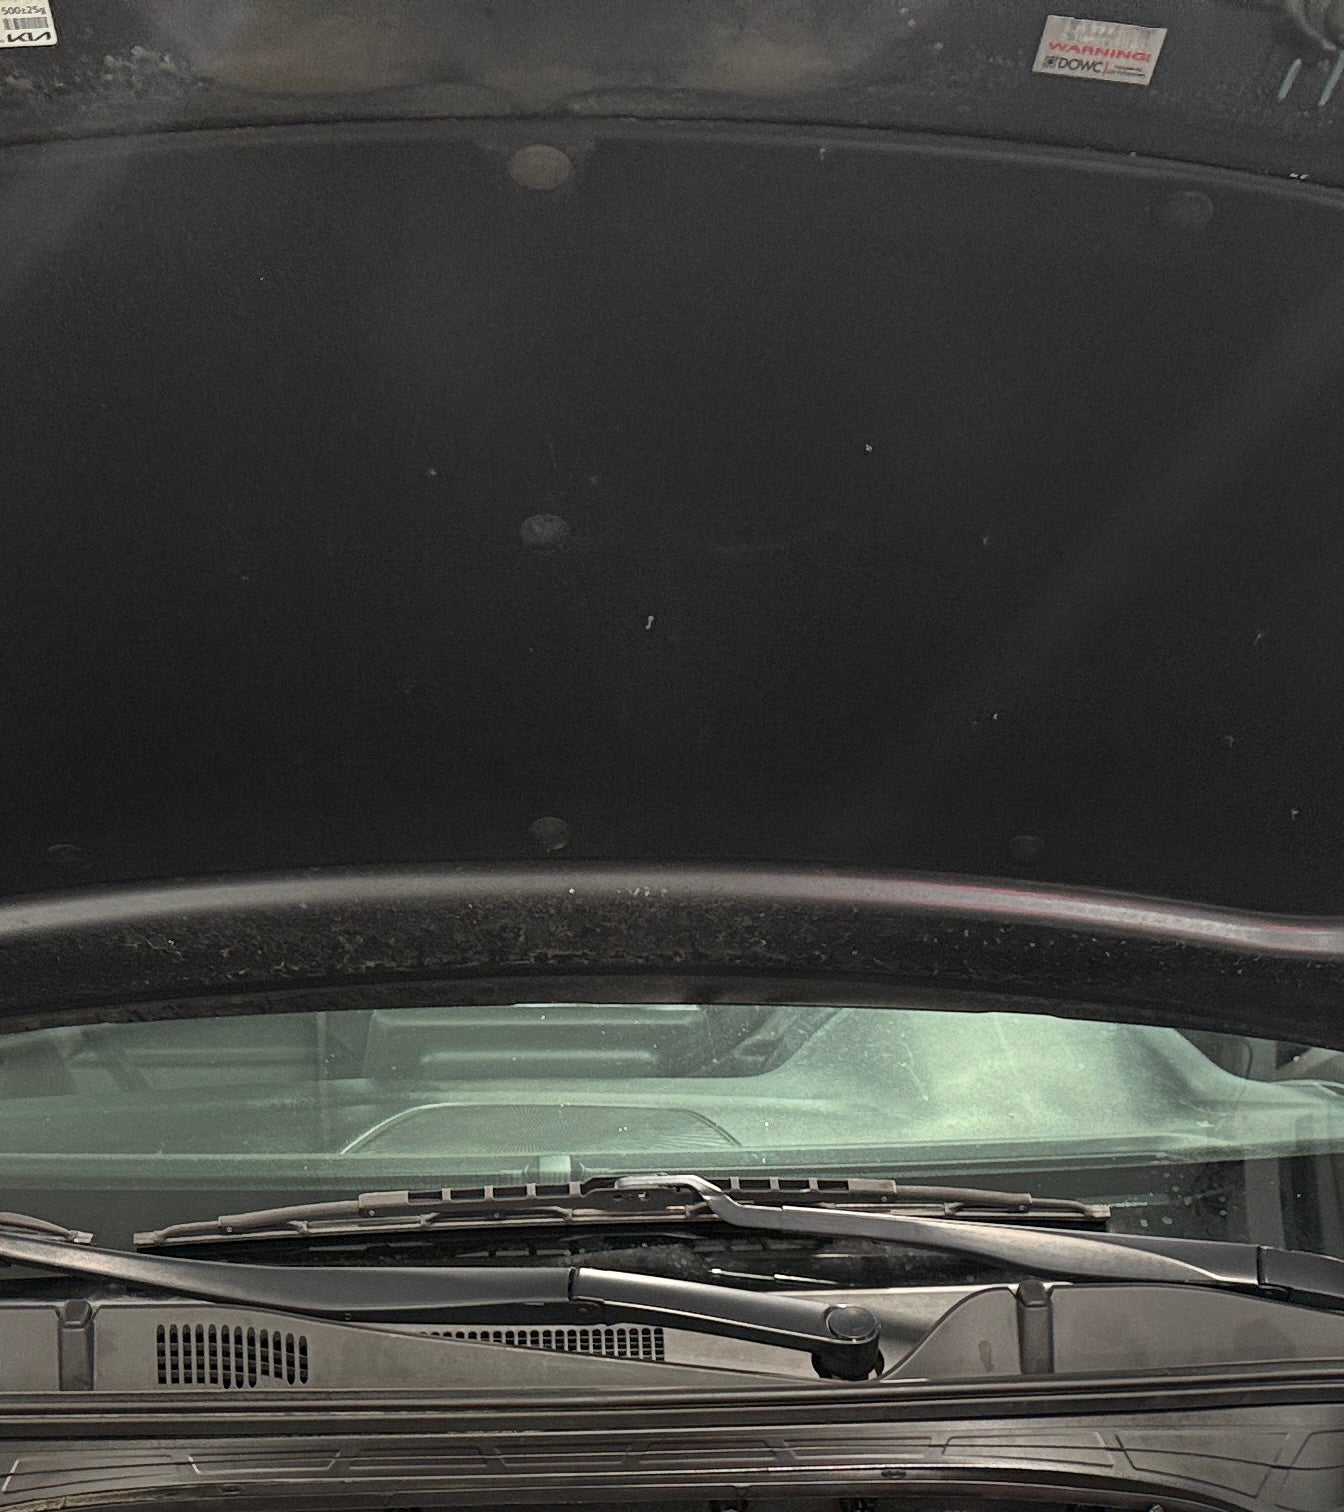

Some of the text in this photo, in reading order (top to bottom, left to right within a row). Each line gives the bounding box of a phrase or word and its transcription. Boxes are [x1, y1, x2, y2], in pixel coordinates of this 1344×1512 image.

[7, 32, 51, 43] KIA
[1048, 41, 1152, 63] WARNING!
[1058, 56, 1103, 73] DOWC
